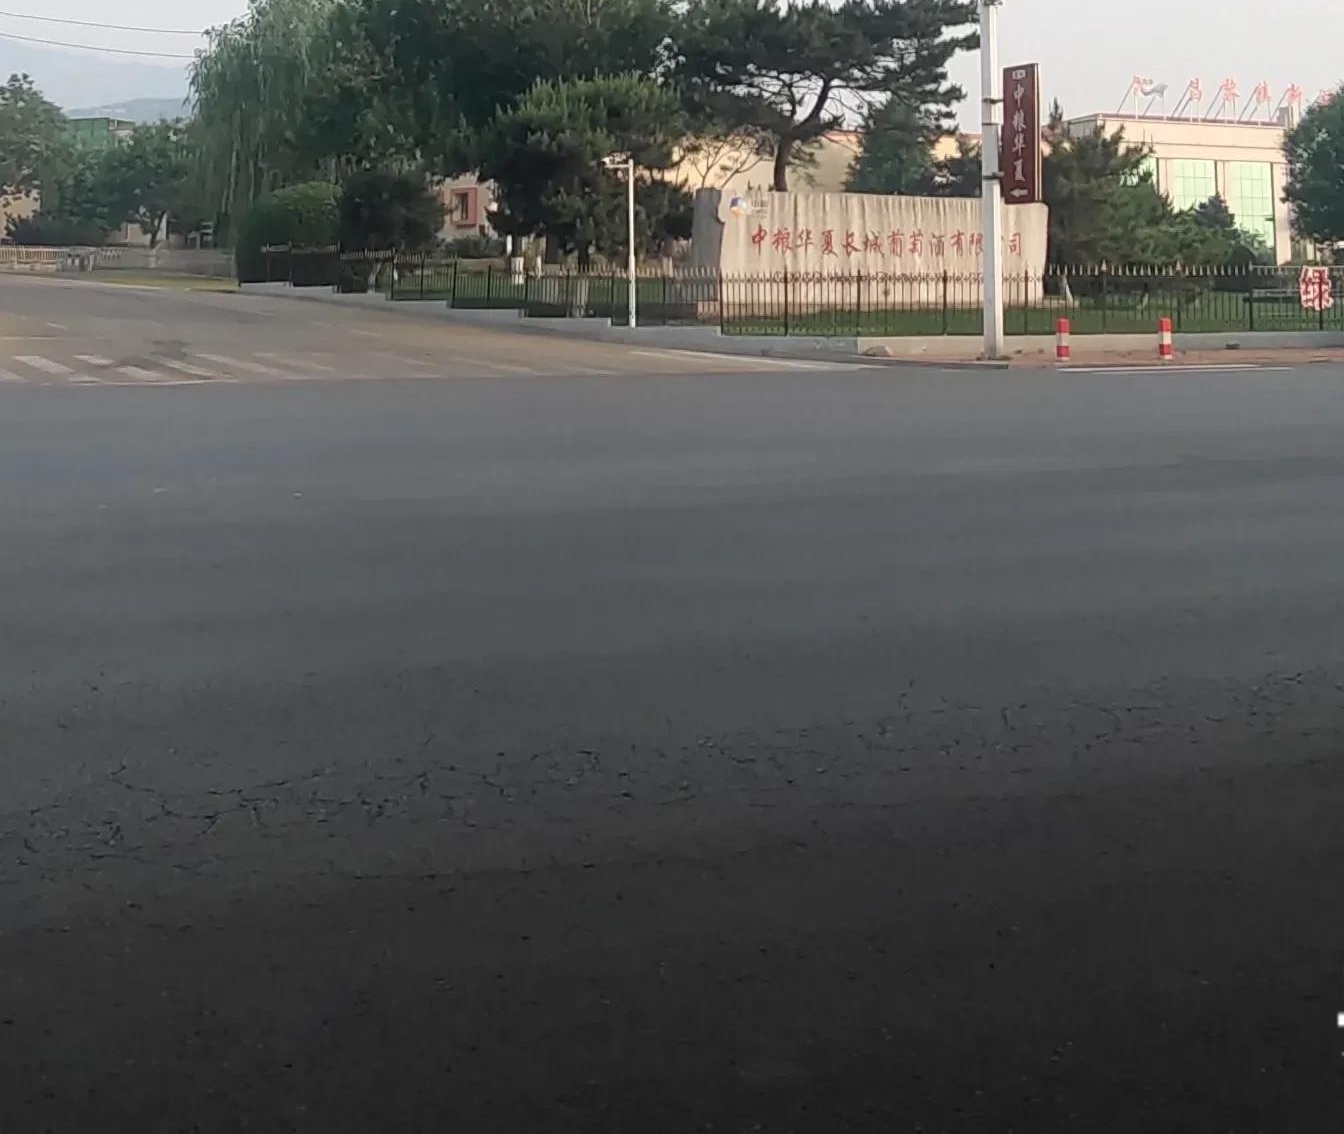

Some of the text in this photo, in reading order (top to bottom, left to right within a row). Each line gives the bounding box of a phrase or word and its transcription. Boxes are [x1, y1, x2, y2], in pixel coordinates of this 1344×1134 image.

[1012, 83, 1027, 182] 中粮华夏
[751, 223, 1023, 258] 中粮华夏长城葡萄酒有限司
